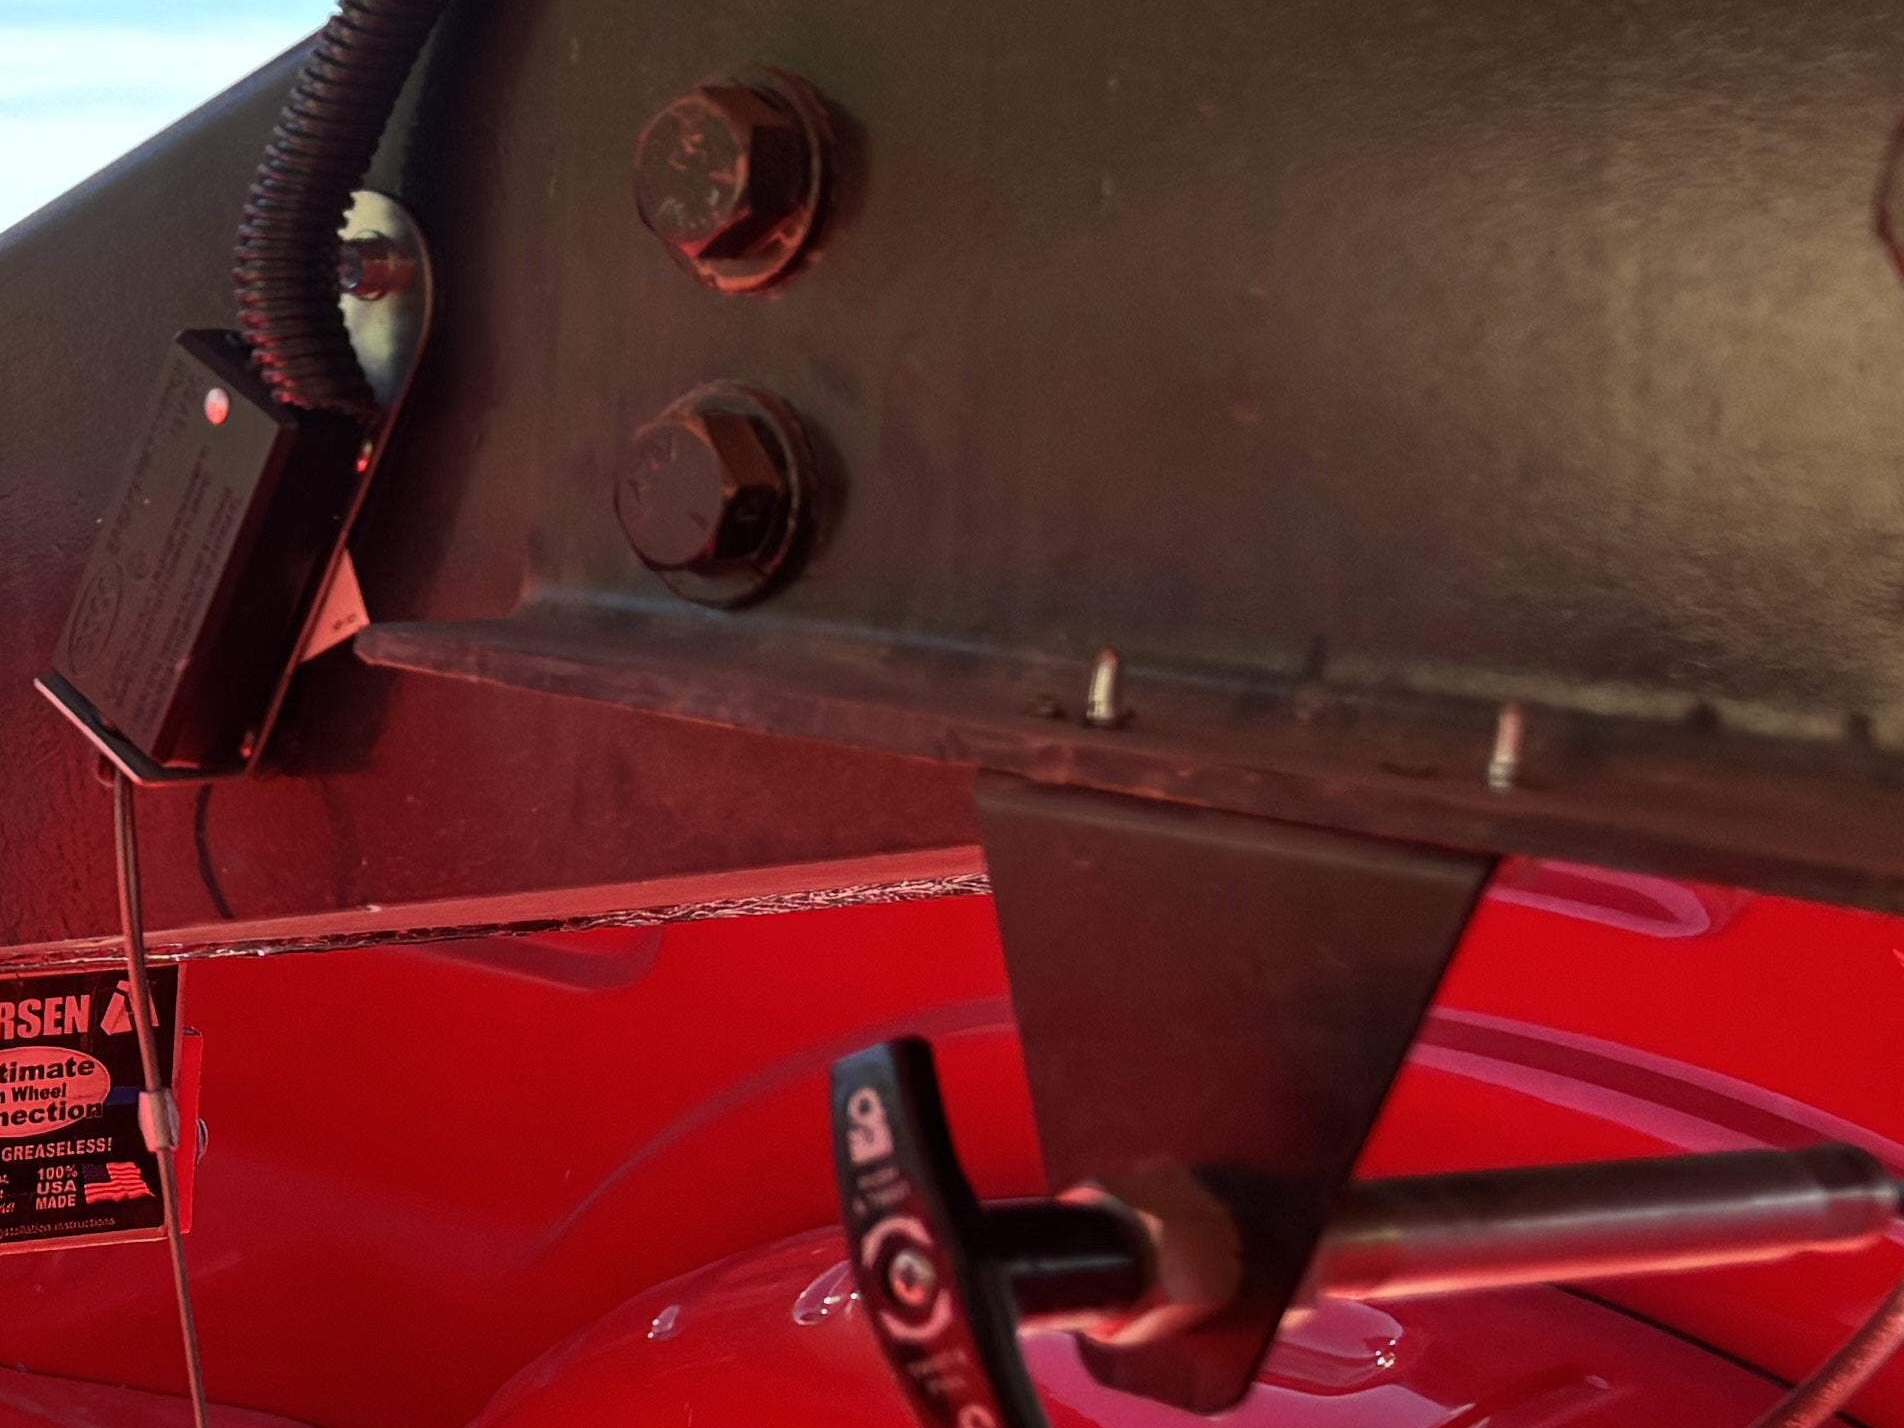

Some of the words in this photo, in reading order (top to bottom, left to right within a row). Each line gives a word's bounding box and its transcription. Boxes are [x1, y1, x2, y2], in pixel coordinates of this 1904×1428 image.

[11, 1083, 67, 1102] Wheel
[2, 1137, 113, 1162] GREASELESS!
[37, 1165, 78, 1181] 100%
[37, 1180, 77, 1194] USA
[35, 1194, 76, 1210] MADE
